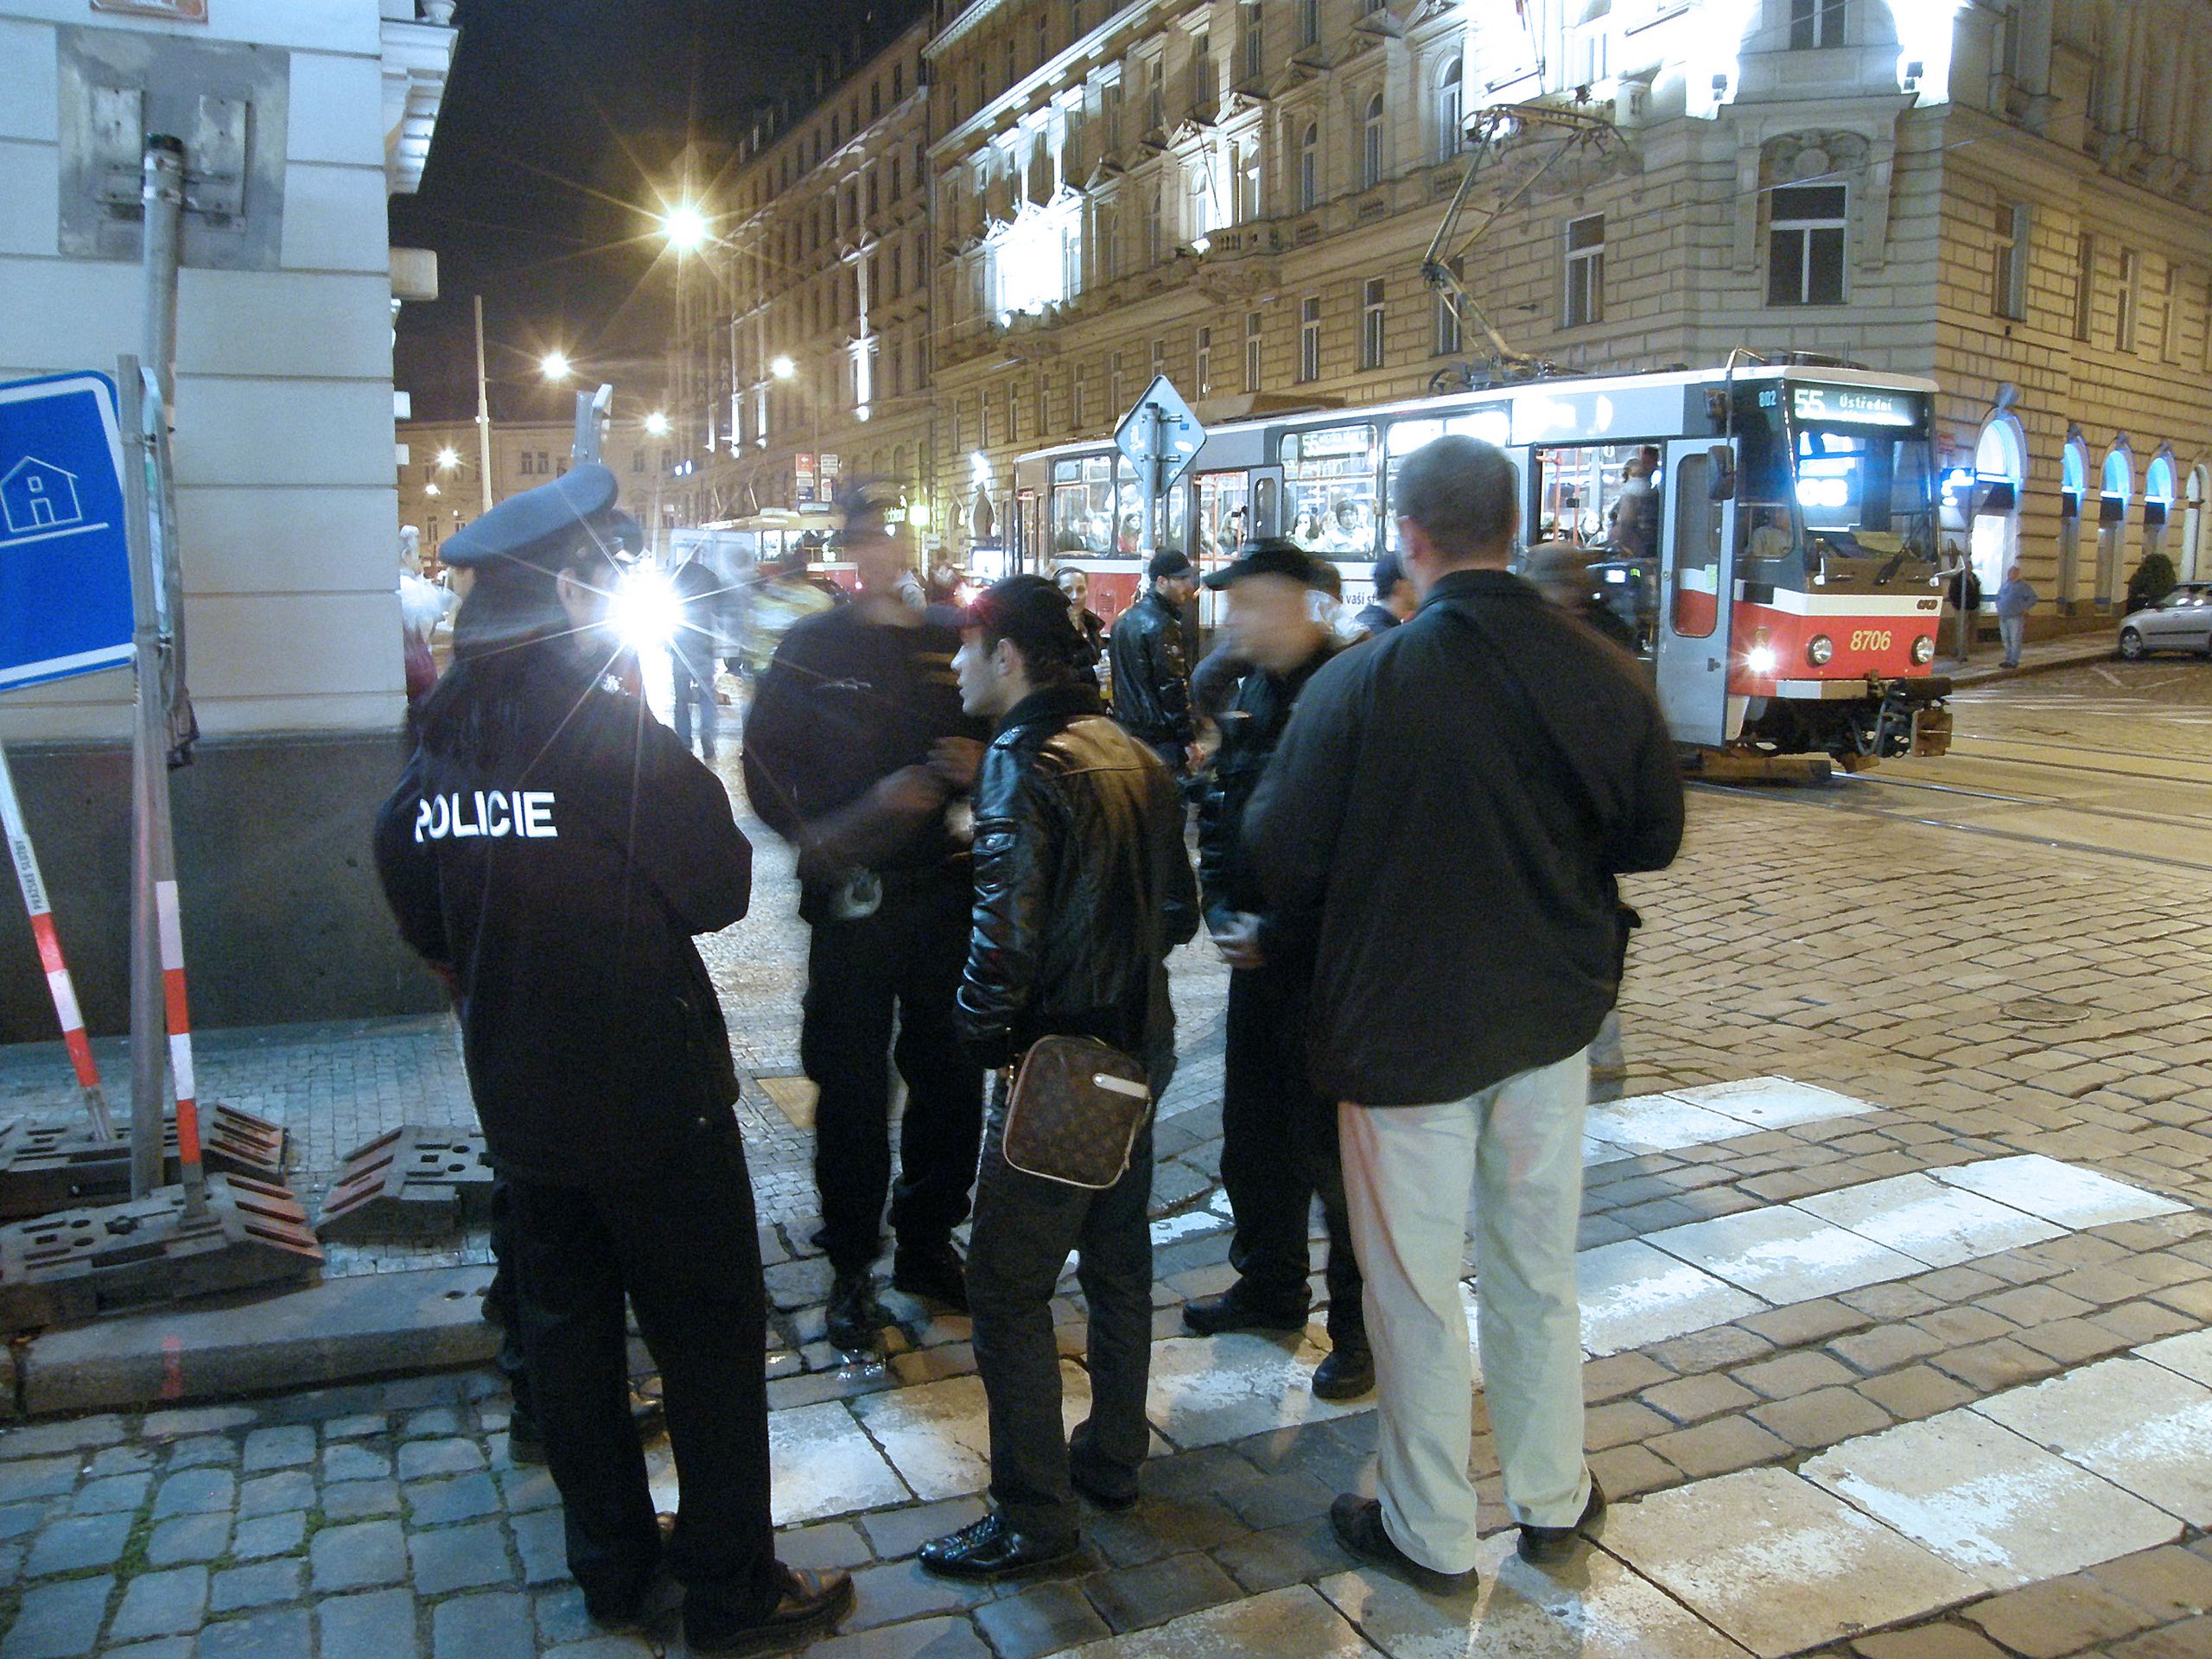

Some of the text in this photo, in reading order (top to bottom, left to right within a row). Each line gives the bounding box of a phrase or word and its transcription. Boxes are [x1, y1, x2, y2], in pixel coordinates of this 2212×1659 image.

[1795, 389, 1826, 419] 55
[1850, 630, 1892, 652] 8706
[415, 790, 559, 843] POLICIE
